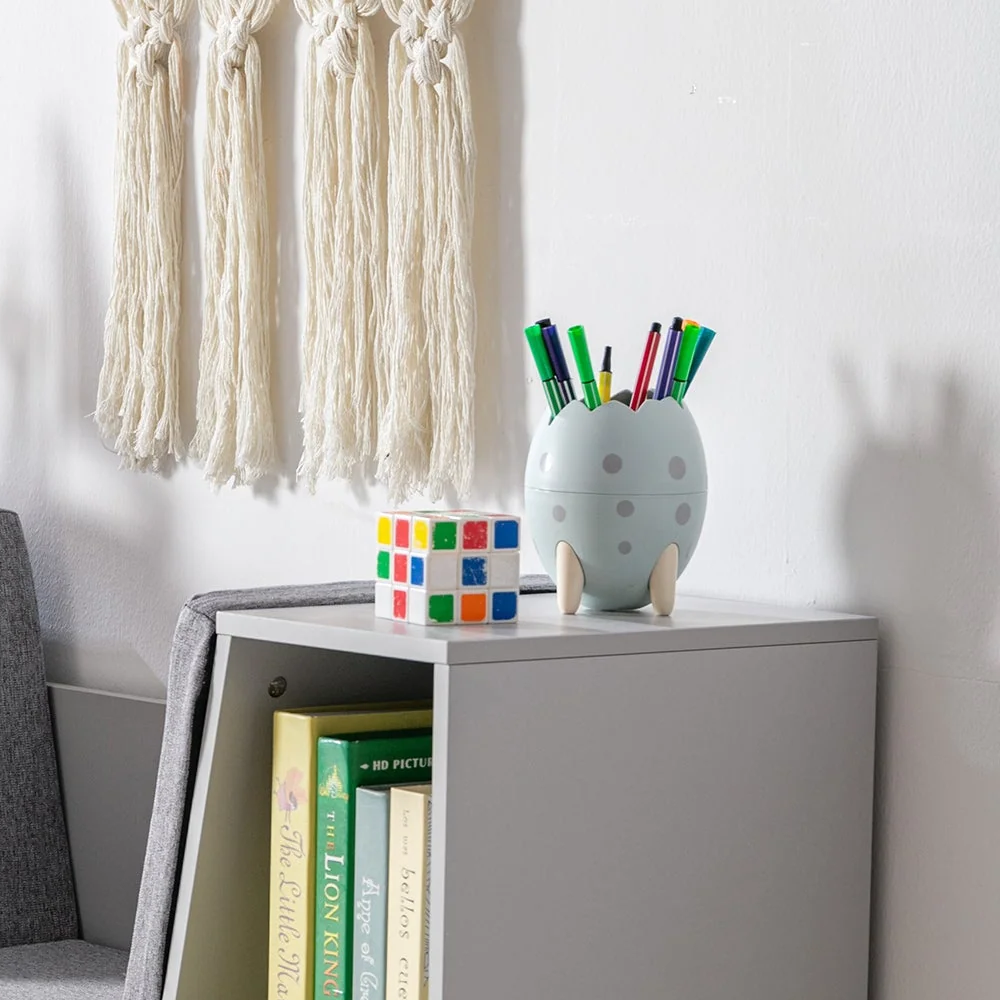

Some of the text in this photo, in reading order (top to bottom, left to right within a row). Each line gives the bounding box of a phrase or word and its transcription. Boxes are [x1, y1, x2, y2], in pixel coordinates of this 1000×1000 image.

[372, 760, 389, 771] HD
[279, 825, 306, 868] The
[326, 811, 336, 850] THE
[279, 871, 302, 943] Little
[323, 852, 345, 922] LION
[357, 876, 381, 934] Anne
[399, 867, 416, 940] bellos
[323, 930, 343, 997] KING
[361, 942, 375, 966] of
